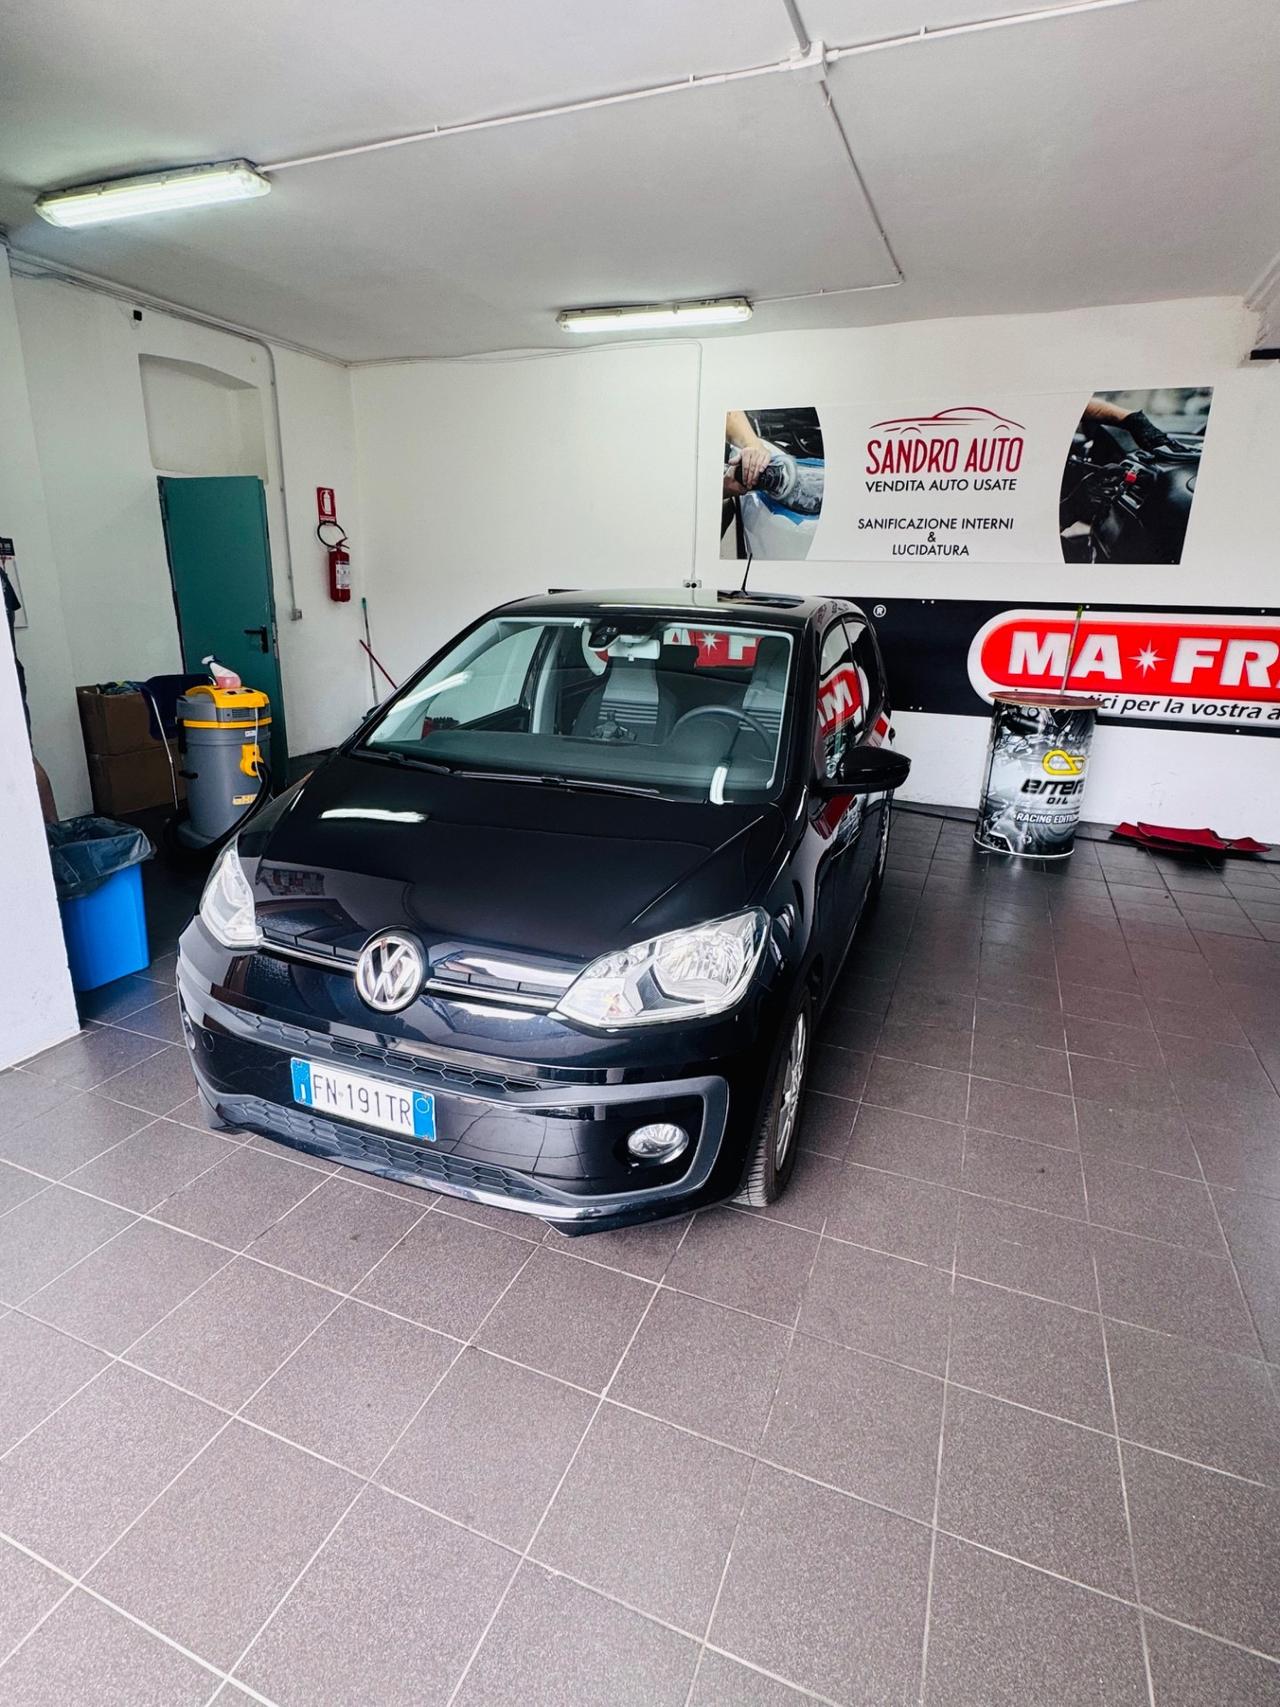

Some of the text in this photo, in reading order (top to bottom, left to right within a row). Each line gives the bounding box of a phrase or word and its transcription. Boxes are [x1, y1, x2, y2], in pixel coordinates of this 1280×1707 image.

[865, 437, 1024, 475] SANDRO AUTO
[865, 478, 1017, 493] VENDITA AUTO USATE
[858, 518, 1014, 530] SANIFICAZIONE INTERNI
[927, 531, 936, 543] &
[892, 544, 970, 556] LUCIDATURA
[1170, 637, 1280, 689] FR
[1120, 698, 1160, 715] per
[1163, 698, 1184, 714] la
[1191, 702, 1262, 719] vostra
[1046, 797, 1069, 805] OIL
[1016, 812, 1053, 824] RACING
